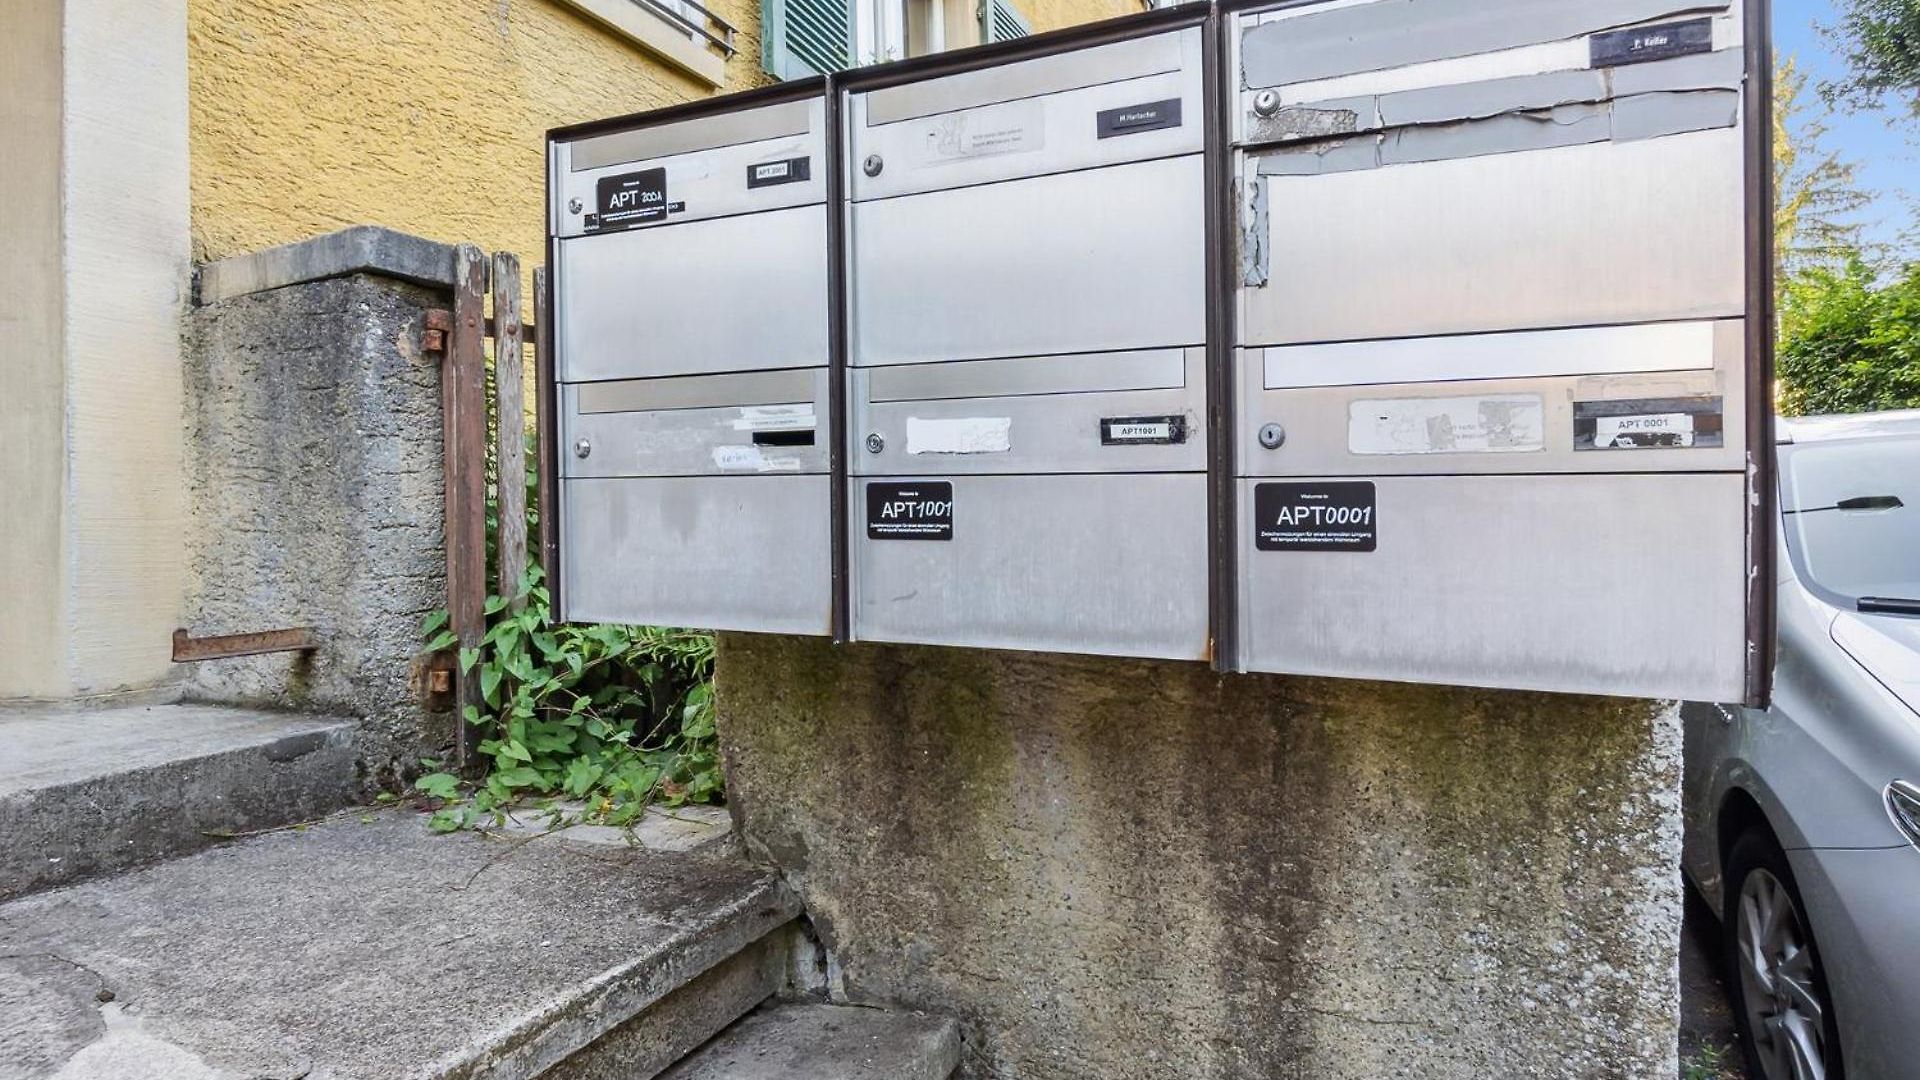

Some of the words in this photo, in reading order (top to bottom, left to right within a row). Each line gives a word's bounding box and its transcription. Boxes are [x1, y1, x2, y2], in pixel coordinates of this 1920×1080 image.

[608, 189, 639, 209] APT
[1121, 427, 1157, 435] APT1001
[1618, 420, 1641, 429] APT
[1644, 419, 1669, 428] 0001
[881, 500, 952, 518] APT1001
[1276, 505, 1373, 525] APT0001
